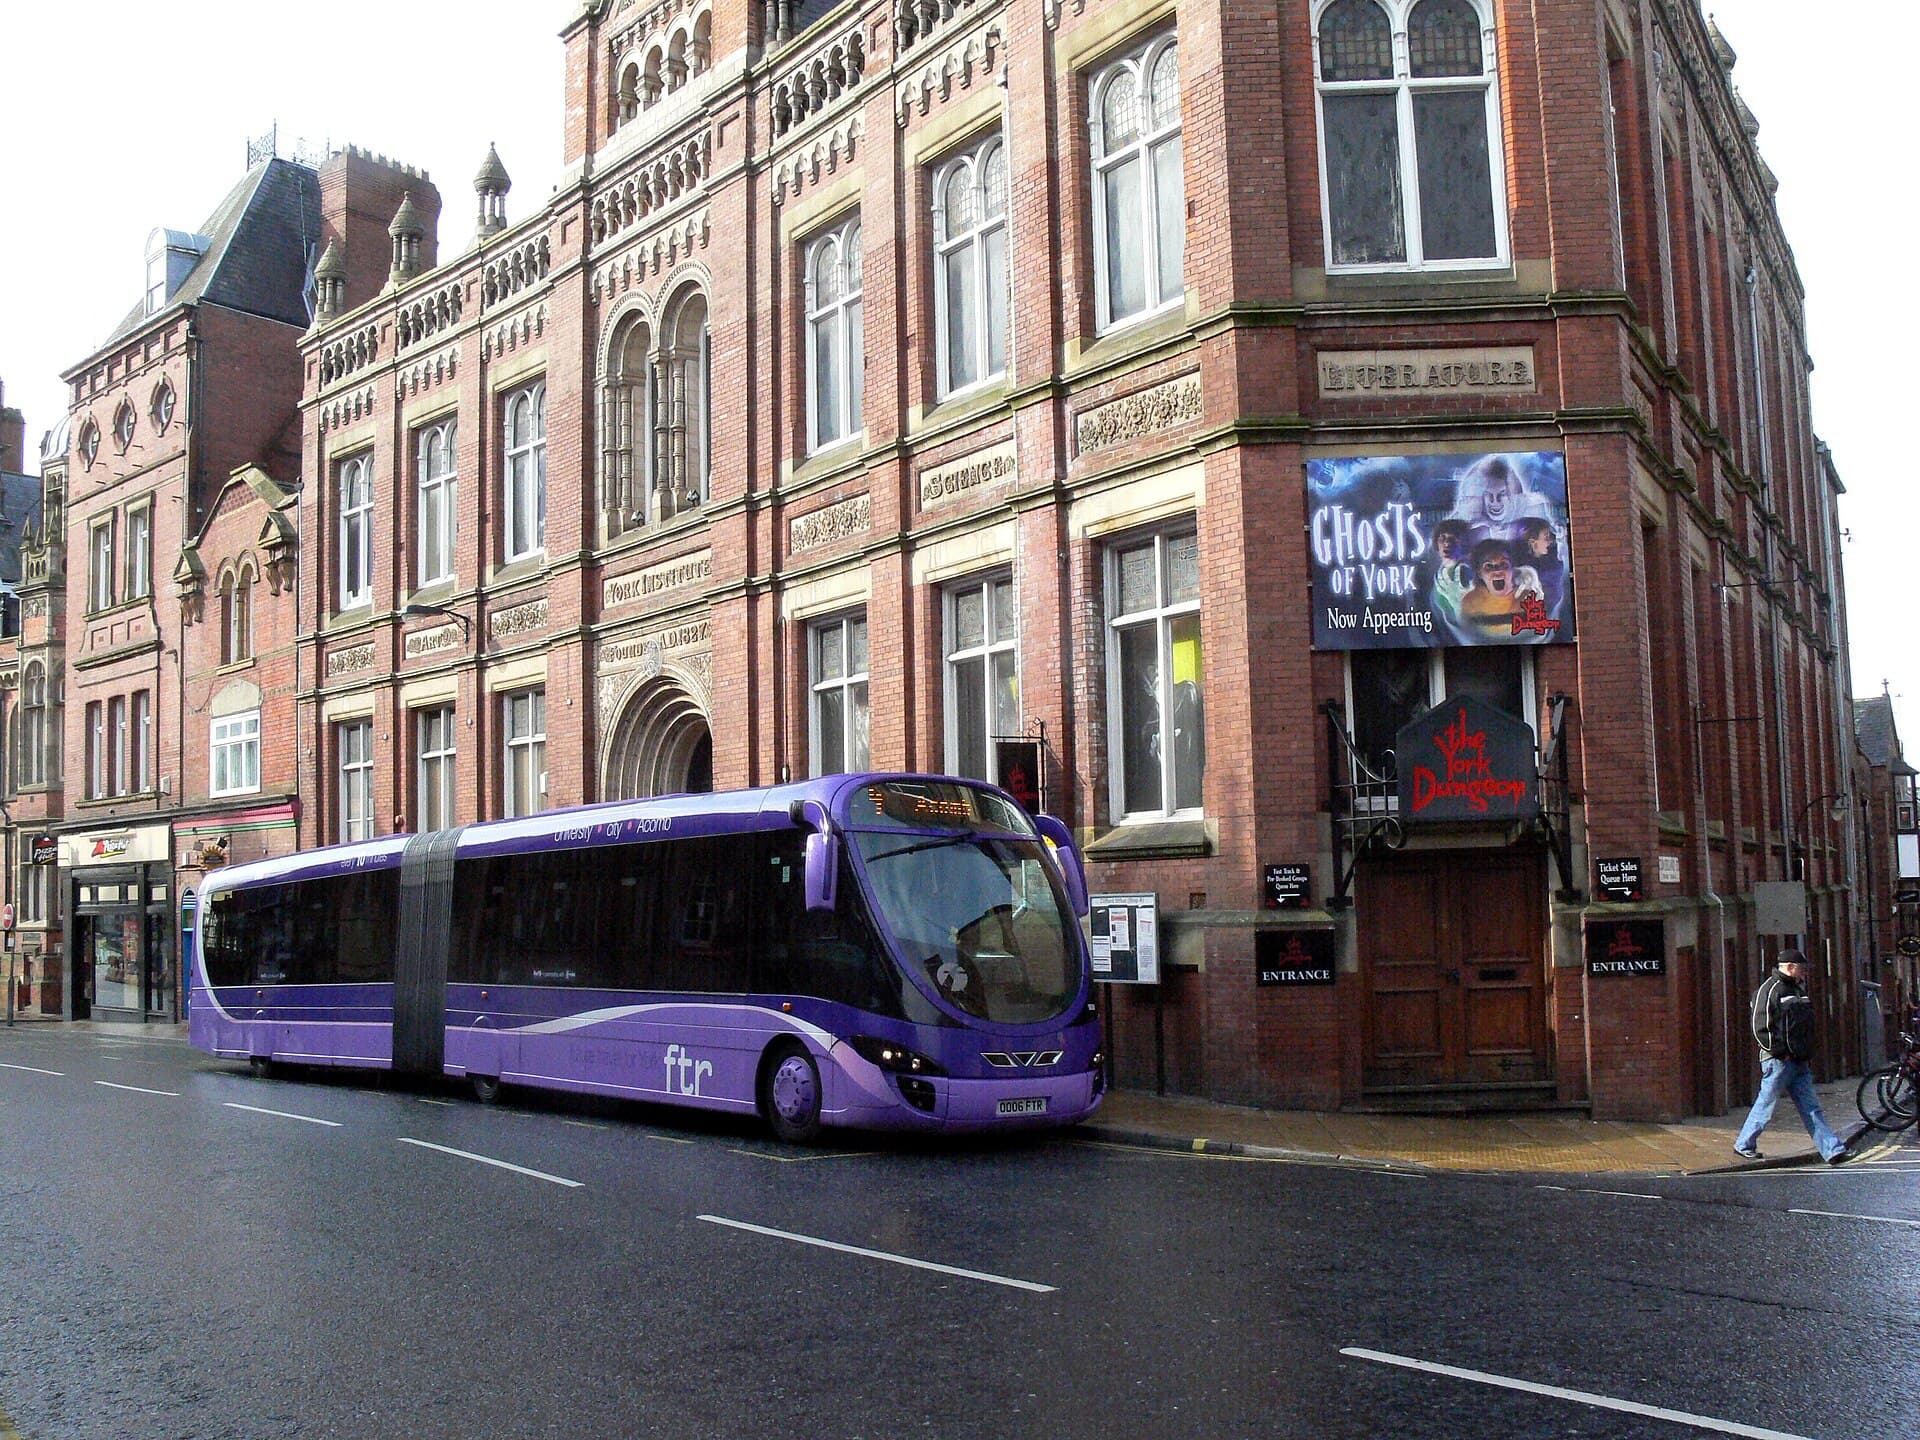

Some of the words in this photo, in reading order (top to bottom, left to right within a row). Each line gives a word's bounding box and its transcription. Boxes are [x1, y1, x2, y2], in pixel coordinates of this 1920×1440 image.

[1312, 501, 1425, 566] GHOSTS
[610, 578, 641, 603] YORK
[641, 559, 712, 595] INSTITUTE
[1331, 565, 1355, 595] OF
[1360, 564, 1417, 599] YORK
[1327, 607, 1357, 629] Now
[1362, 606, 1433, 634] Appearing
[1433, 735, 1491, 780] York
[1411, 766, 1527, 812] Dungeon
[1599, 863, 1619, 873] Ticket
[1620, 862, 1638, 872] Sales
[1600, 875, 1621, 884] Queue
[1622, 873, 1637, 882] Here
[1262, 969, 1330, 981] ENTRANCE
[1592, 960, 1660, 972] ENTRANCE
[663, 1044, 713, 1097] ftr
[1025, 1098, 1043, 1112] FTR
